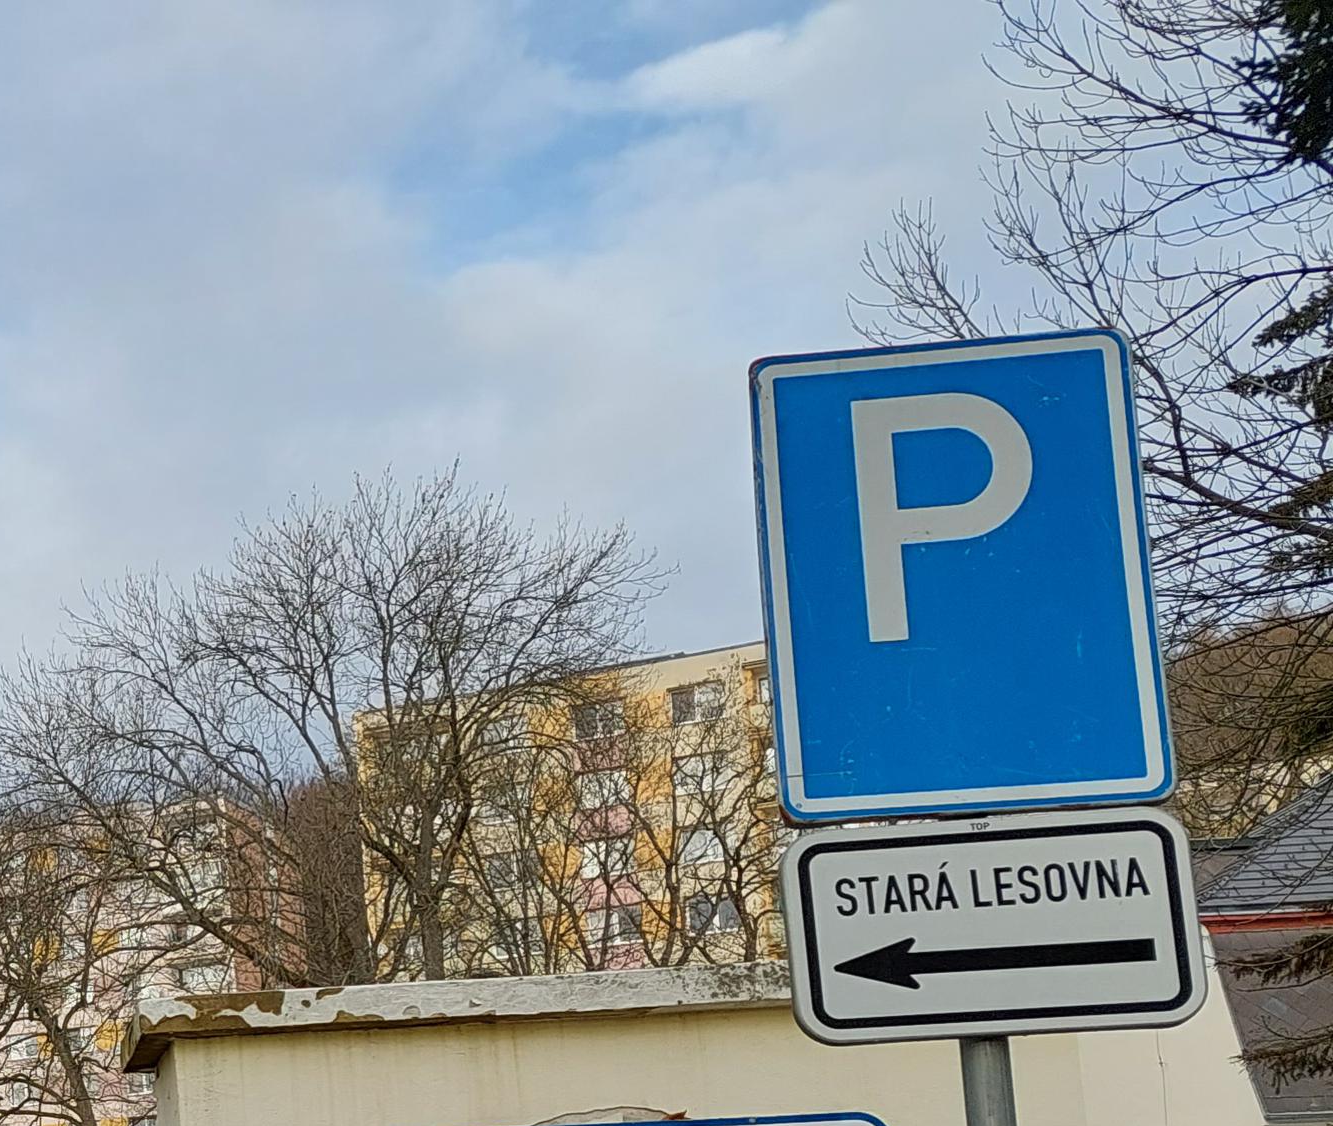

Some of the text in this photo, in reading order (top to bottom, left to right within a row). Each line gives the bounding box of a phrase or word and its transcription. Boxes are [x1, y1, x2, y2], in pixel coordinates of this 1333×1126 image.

[850, 392, 1034, 643] P
[969, 822, 990, 831] TOP
[834, 856, 1151, 917] STARÁ LESOVNA
